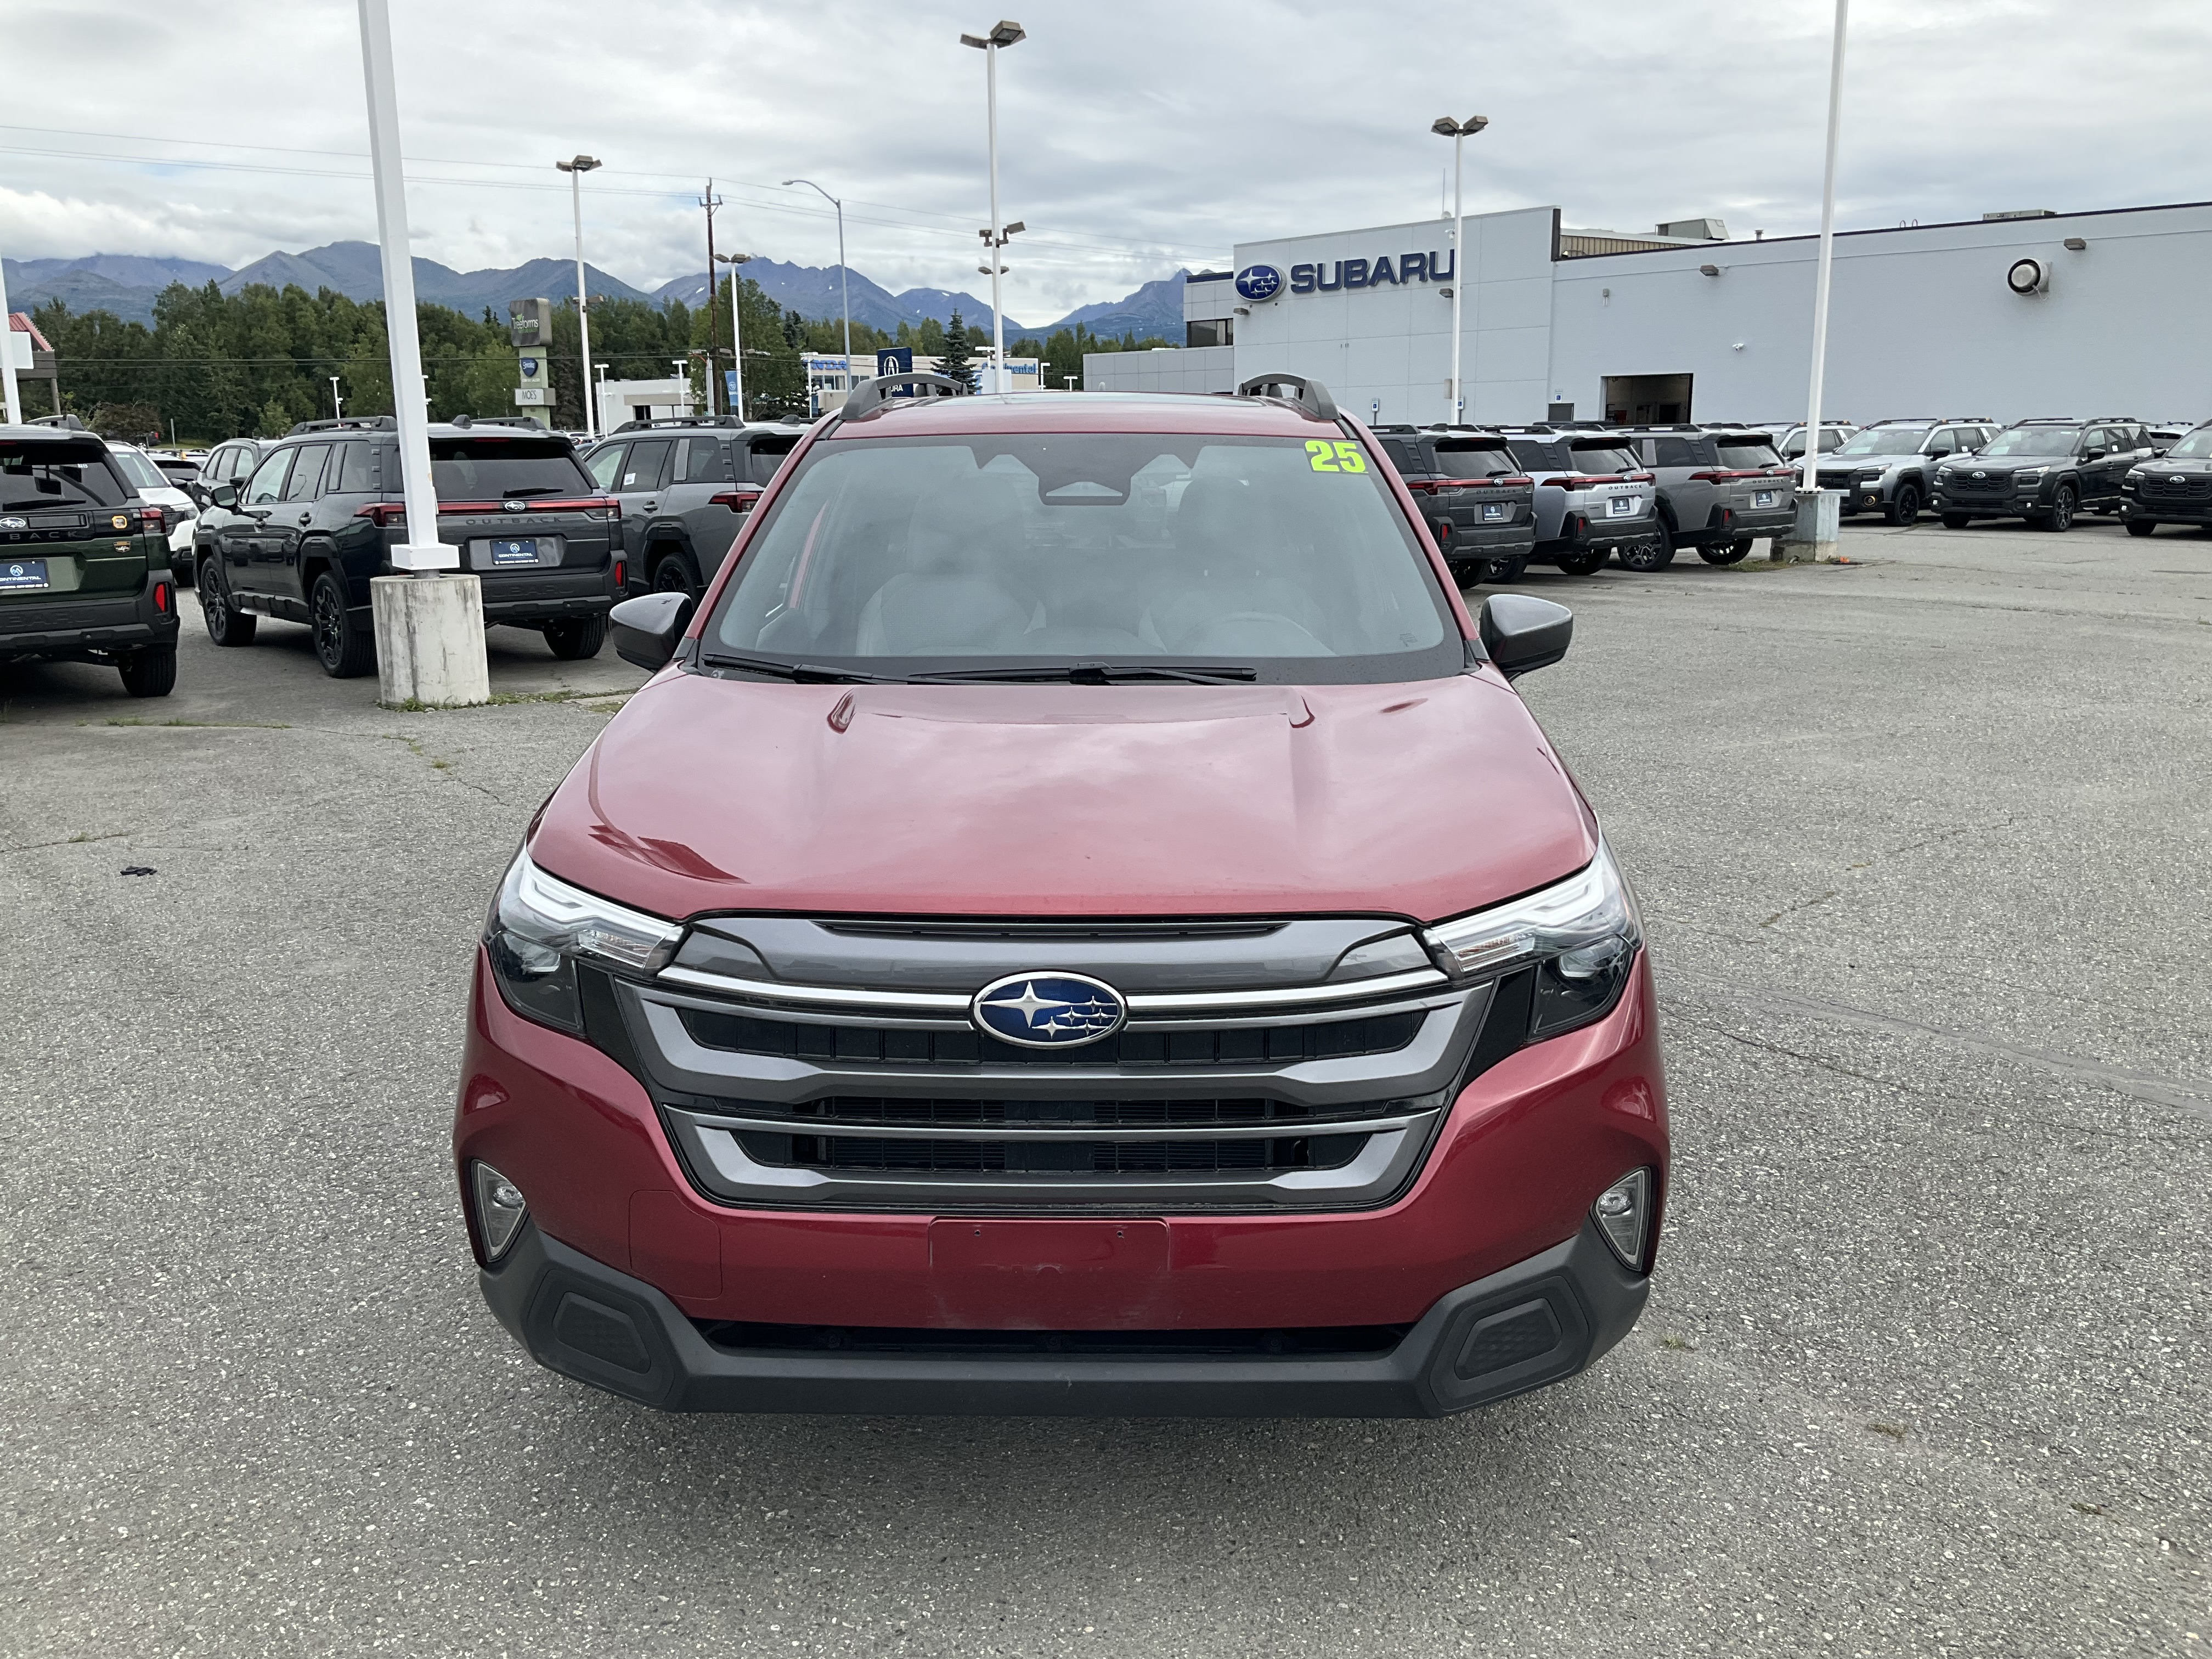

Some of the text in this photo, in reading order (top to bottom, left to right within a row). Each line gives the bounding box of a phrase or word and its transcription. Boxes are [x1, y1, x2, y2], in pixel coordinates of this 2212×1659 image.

[1291, 249, 1454, 293] SUBARU
[1305, 441, 1365, 473] 25
[466, 517, 561, 525] OUTBACK
